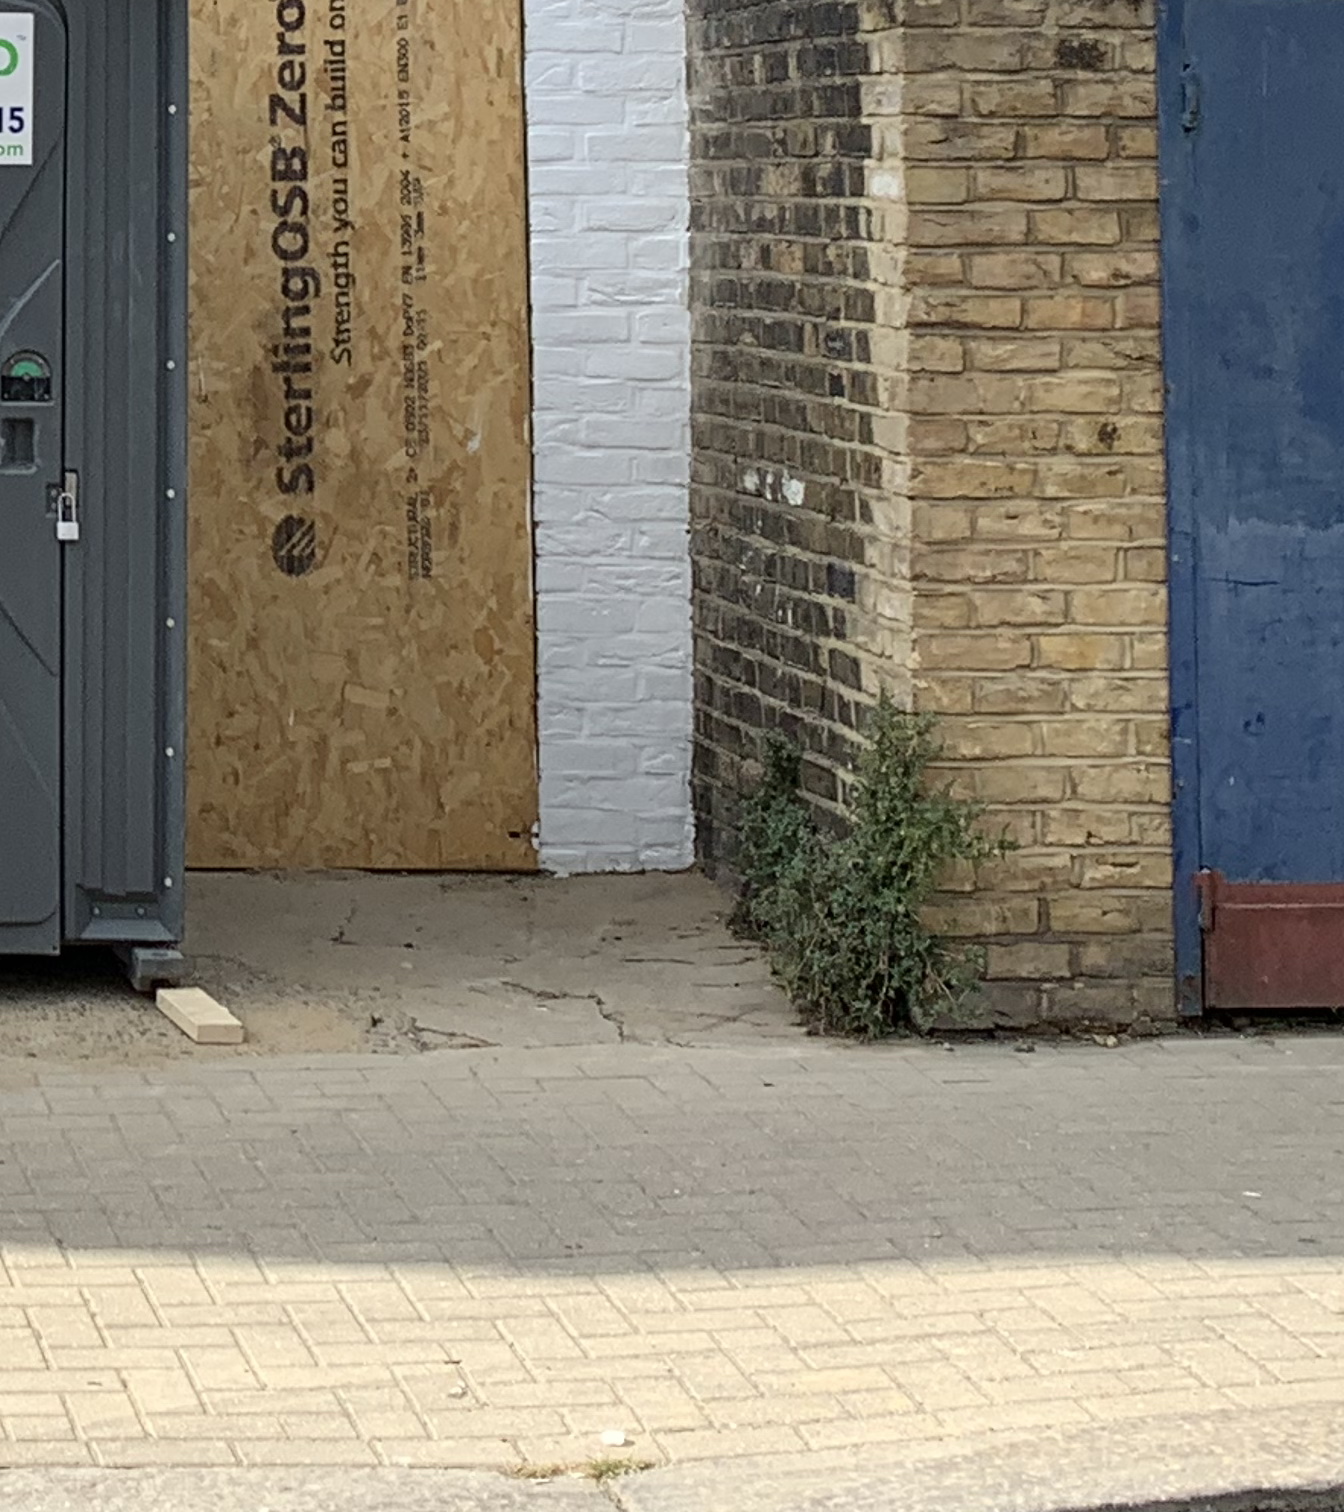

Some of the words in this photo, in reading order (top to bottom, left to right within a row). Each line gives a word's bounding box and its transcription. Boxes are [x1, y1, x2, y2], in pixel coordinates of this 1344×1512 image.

[323, 38, 347, 111] build
[328, 119, 348, 167] can
[330, 177, 356, 231] you
[325, 239, 356, 366] Strength
